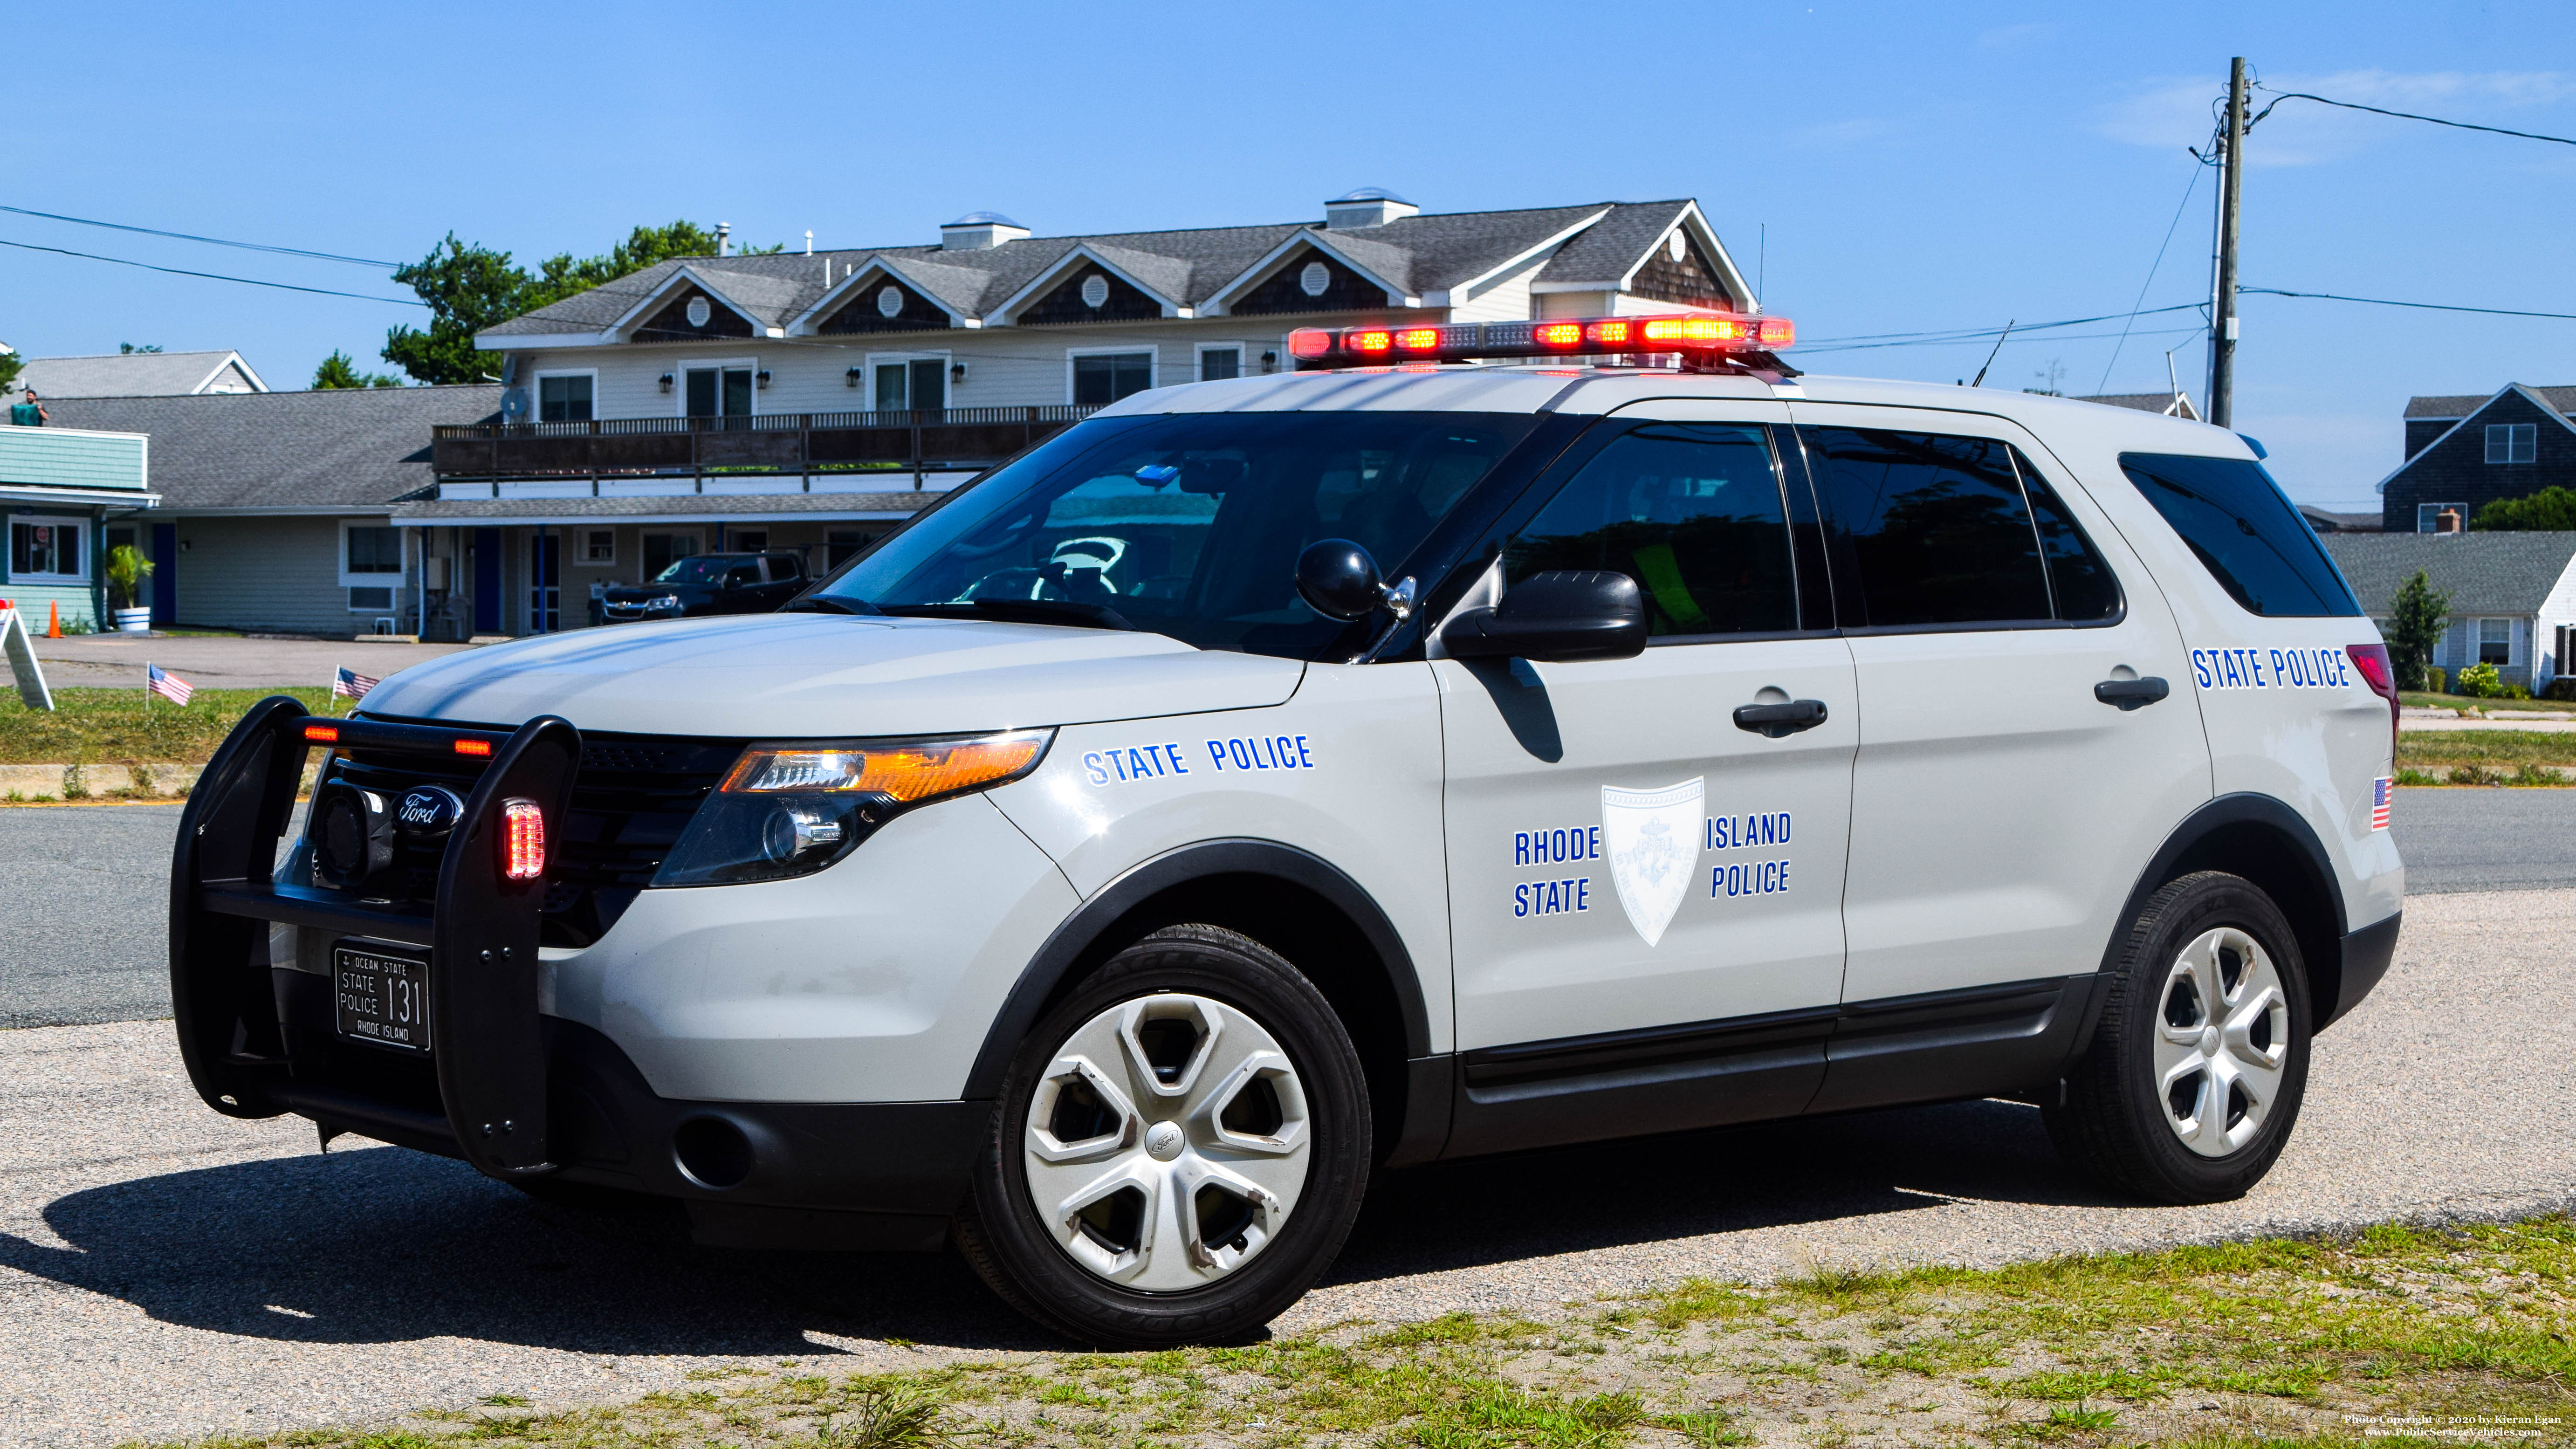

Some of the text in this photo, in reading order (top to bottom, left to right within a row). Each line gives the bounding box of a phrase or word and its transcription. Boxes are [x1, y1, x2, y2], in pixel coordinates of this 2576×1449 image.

[2191, 647, 2350, 690] STATE POLICE
[1081, 734, 1315, 787] STATE POLICE
[399, 794, 440, 823] Ford
[1514, 811, 1792, 867] RHODE ISLAND
[1513, 877, 1590, 919] STATE
[1710, 859, 1790, 900] POLICE
[355, 957, 407, 976] OCEAN STATE
[343, 972, 375, 993] STATE
[340, 993, 378, 1015] POLICE
[388, 977, 420, 1025] 131
[357, 1020, 409, 1041] RHODE ISLAND
[1157, 1133, 1175, 1150] Ford
